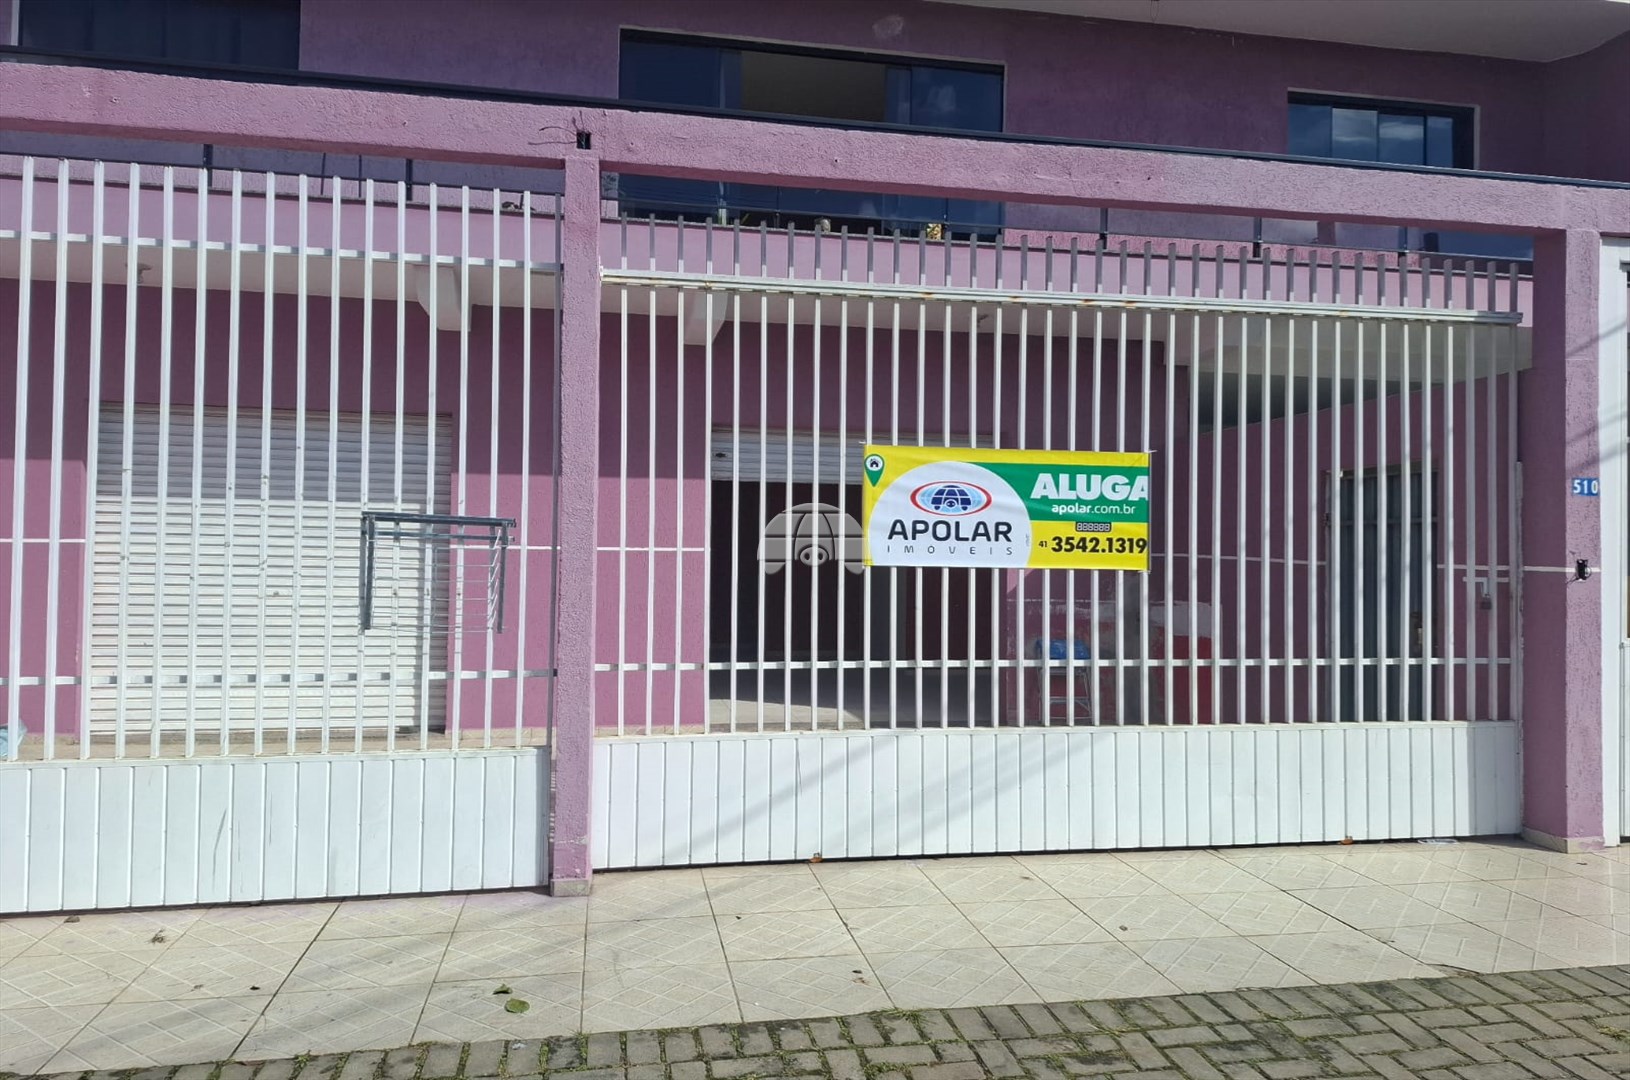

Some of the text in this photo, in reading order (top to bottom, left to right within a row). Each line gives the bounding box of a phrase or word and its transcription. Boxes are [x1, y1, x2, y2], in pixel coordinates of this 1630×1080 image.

[1030, 473, 1148, 501] ALUGA
[1573, 479, 1599, 494] 510
[1051, 502, 1136, 515] apolar.com.br
[887, 519, 1012, 542] APOLAR
[1051, 536, 1147, 554] 3542.1319
